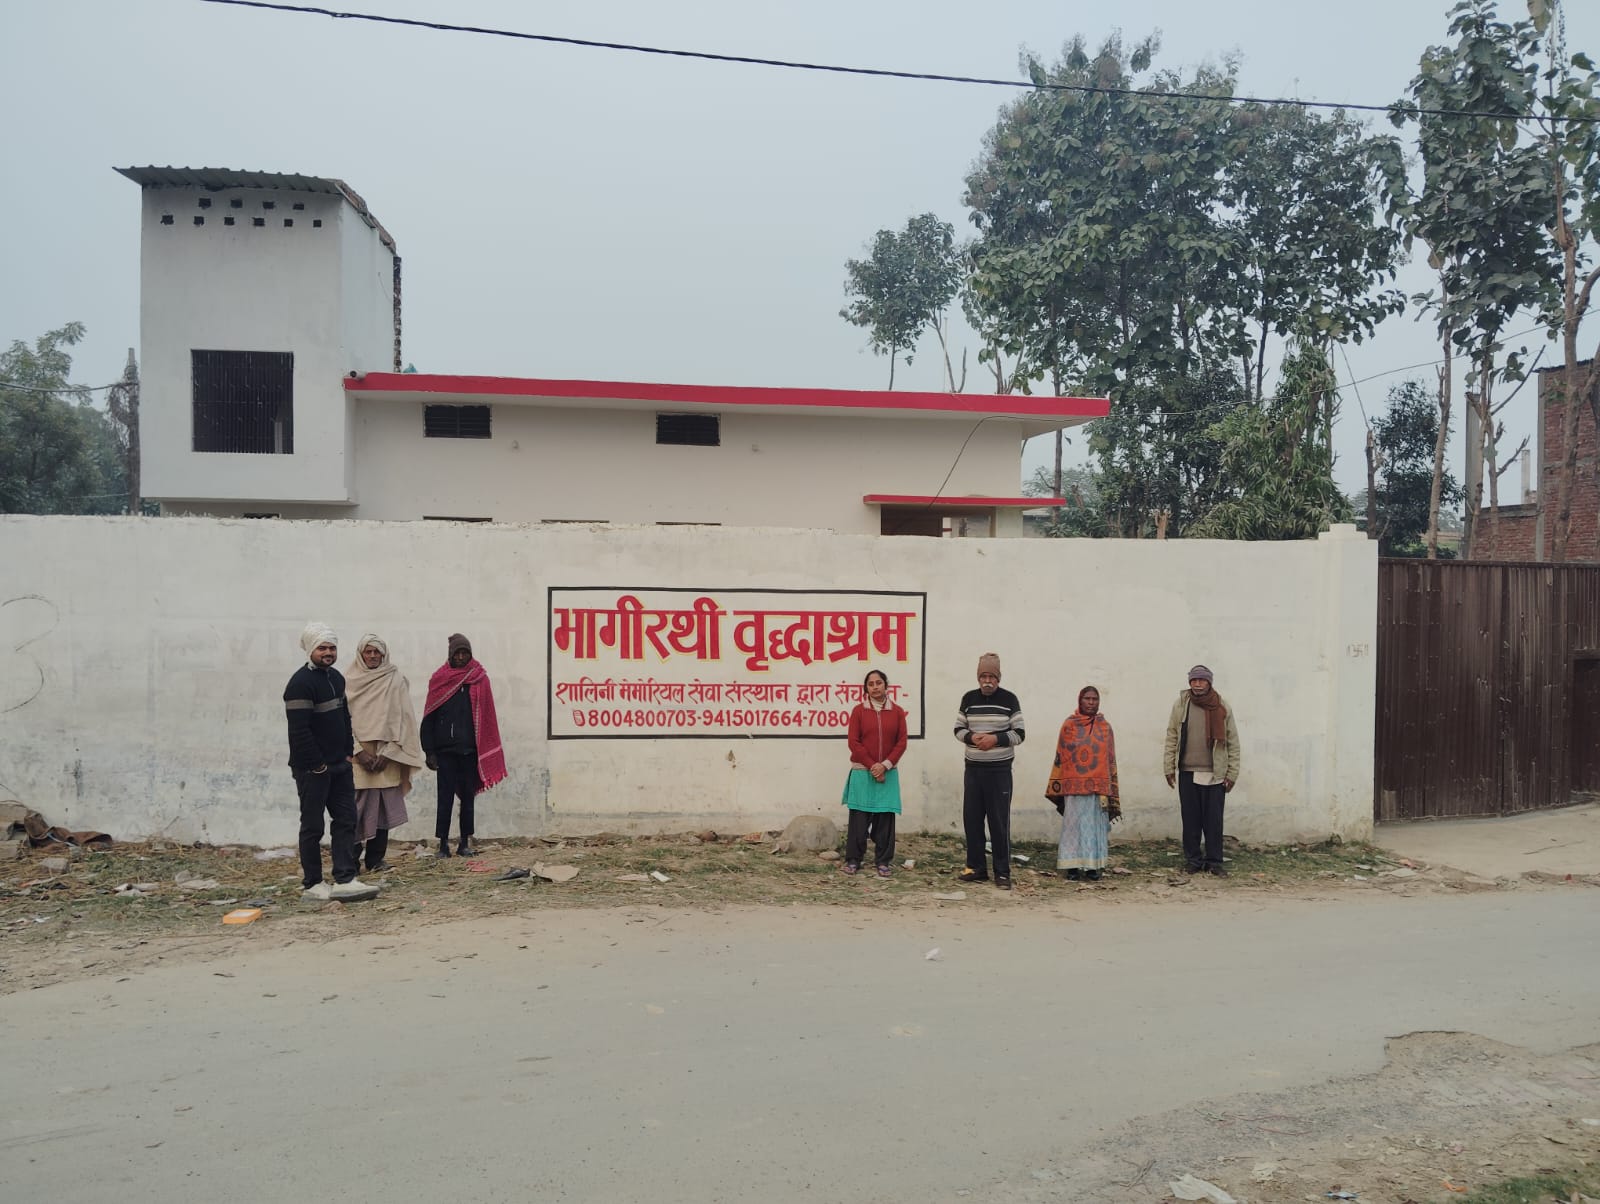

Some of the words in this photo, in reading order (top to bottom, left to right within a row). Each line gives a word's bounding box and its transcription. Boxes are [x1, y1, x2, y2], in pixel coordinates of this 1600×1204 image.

[552, 594, 728, 662] भागीरथी
[555, 676, 617, 705] शालिनी
[619, 678, 686, 705] मेमोरियल
[688, 678, 723, 704] सेवा
[725, 680, 791, 705] संस्थान
[797, 683, 831, 705] द्वारा
